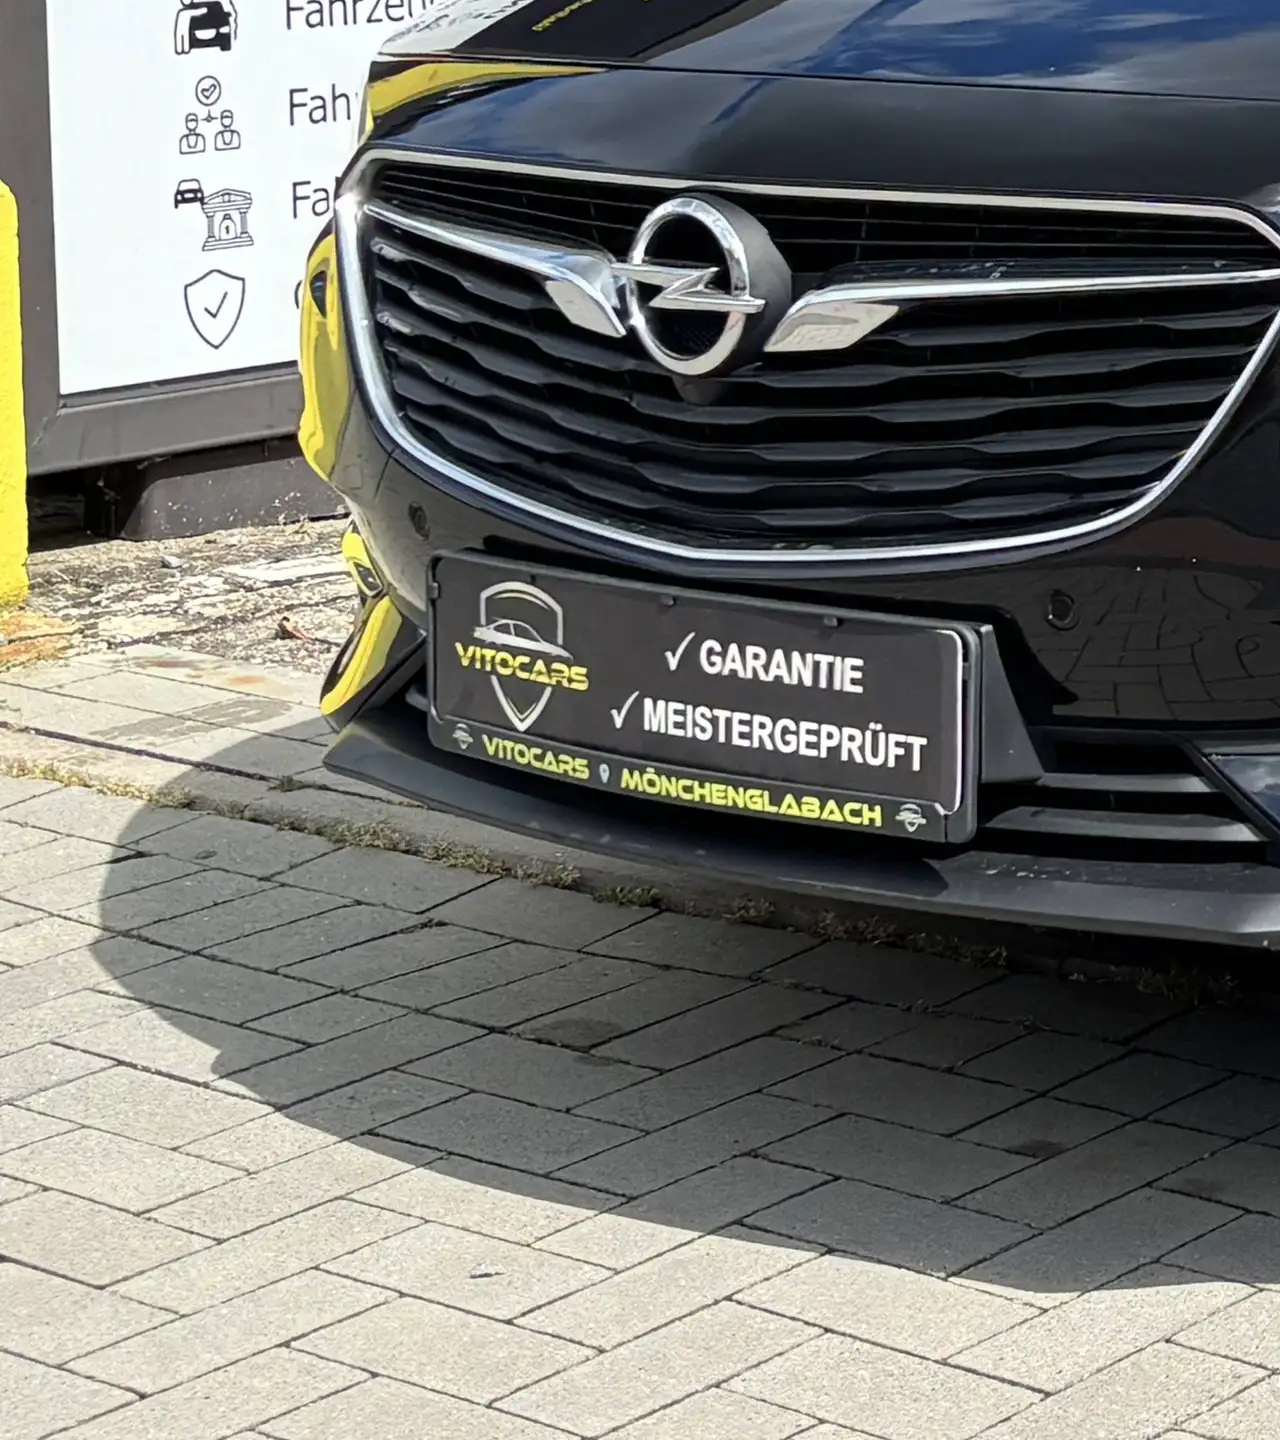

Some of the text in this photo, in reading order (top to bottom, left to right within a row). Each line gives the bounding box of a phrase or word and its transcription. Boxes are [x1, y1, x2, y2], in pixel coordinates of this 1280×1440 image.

[288, 83, 358, 126] Fah
[455, 640, 590, 692] VITOCARS
[699, 638, 865, 694] GARANTIE
[641, 696, 928, 772] MEISTERGEPRÜFT
[481, 733, 886, 827] VITOCARS MÖNCHENGLABACH
